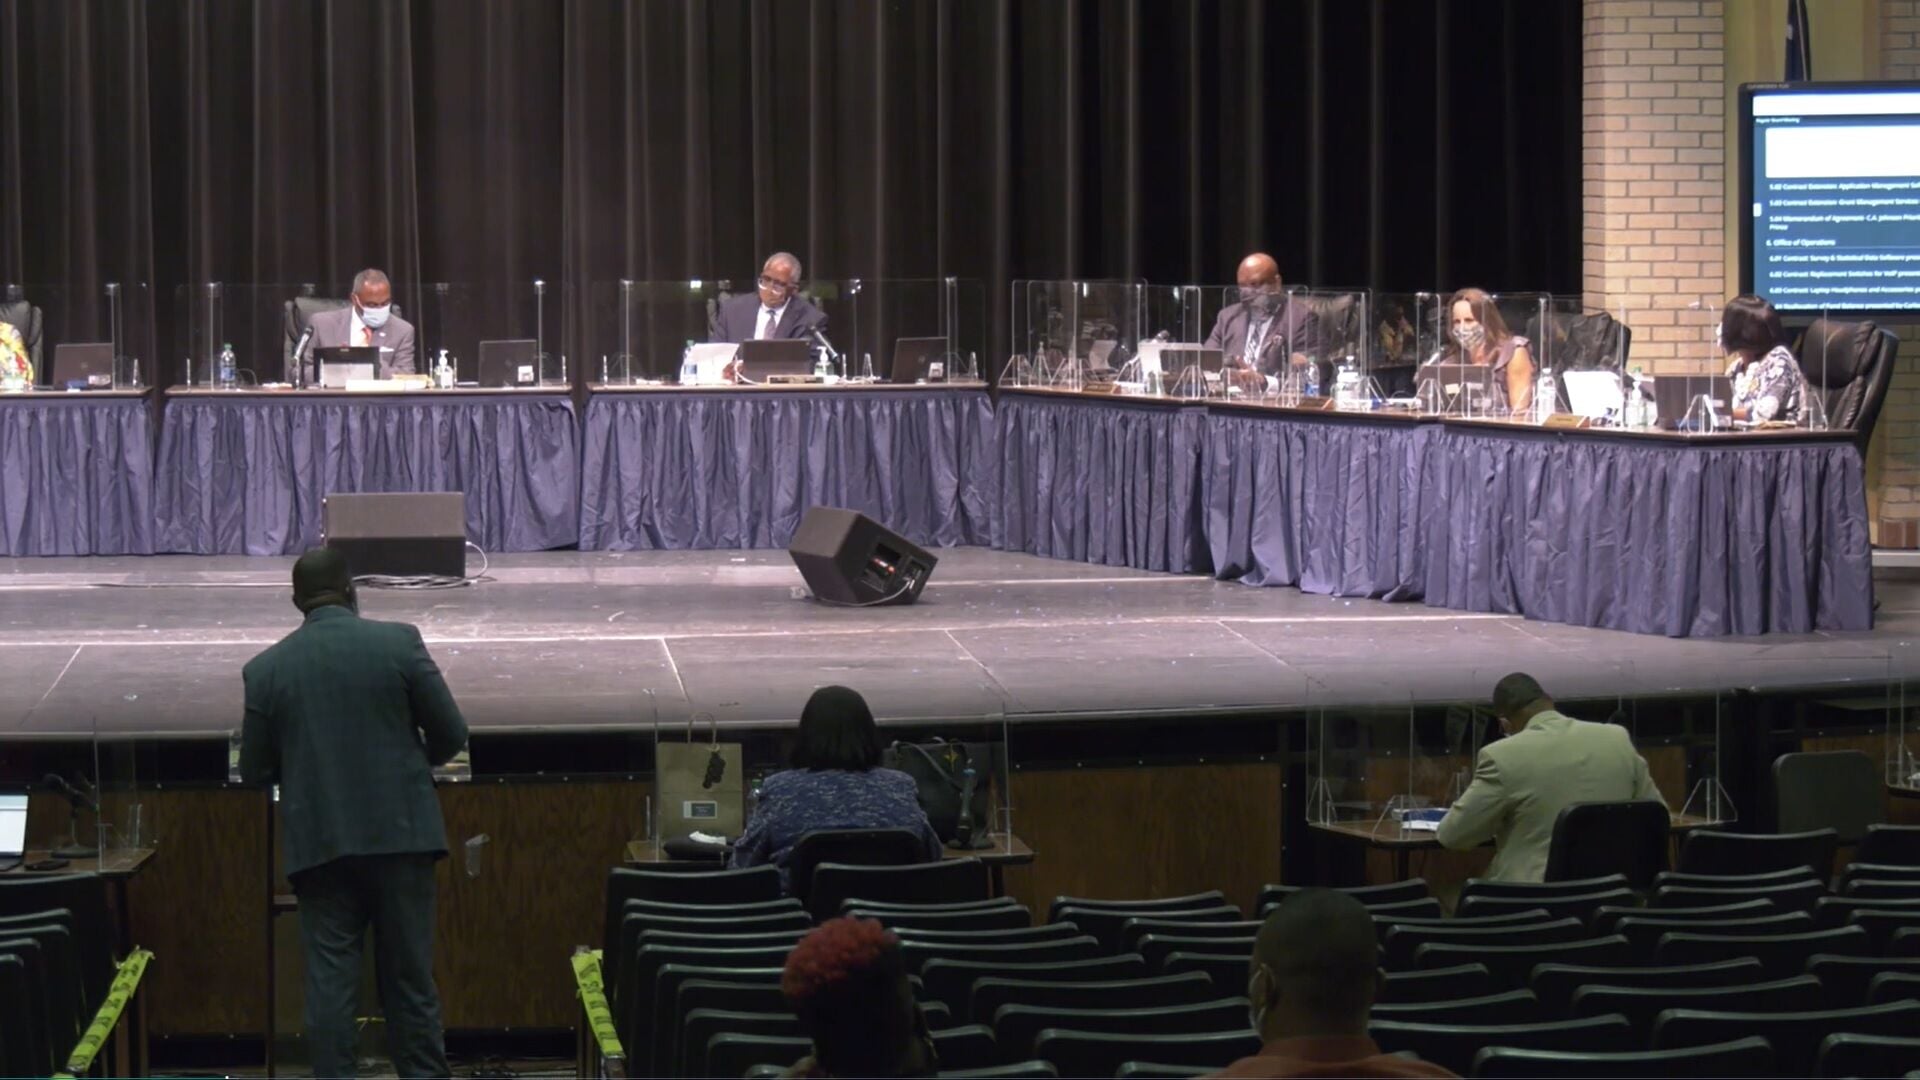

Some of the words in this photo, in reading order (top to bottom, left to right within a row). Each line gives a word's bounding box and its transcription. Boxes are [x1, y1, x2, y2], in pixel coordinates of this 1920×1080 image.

[1800, 239, 1835, 247] Operations
[1810, 255, 1829, 263] Survey
[1810, 271, 1847, 279] Replacement
